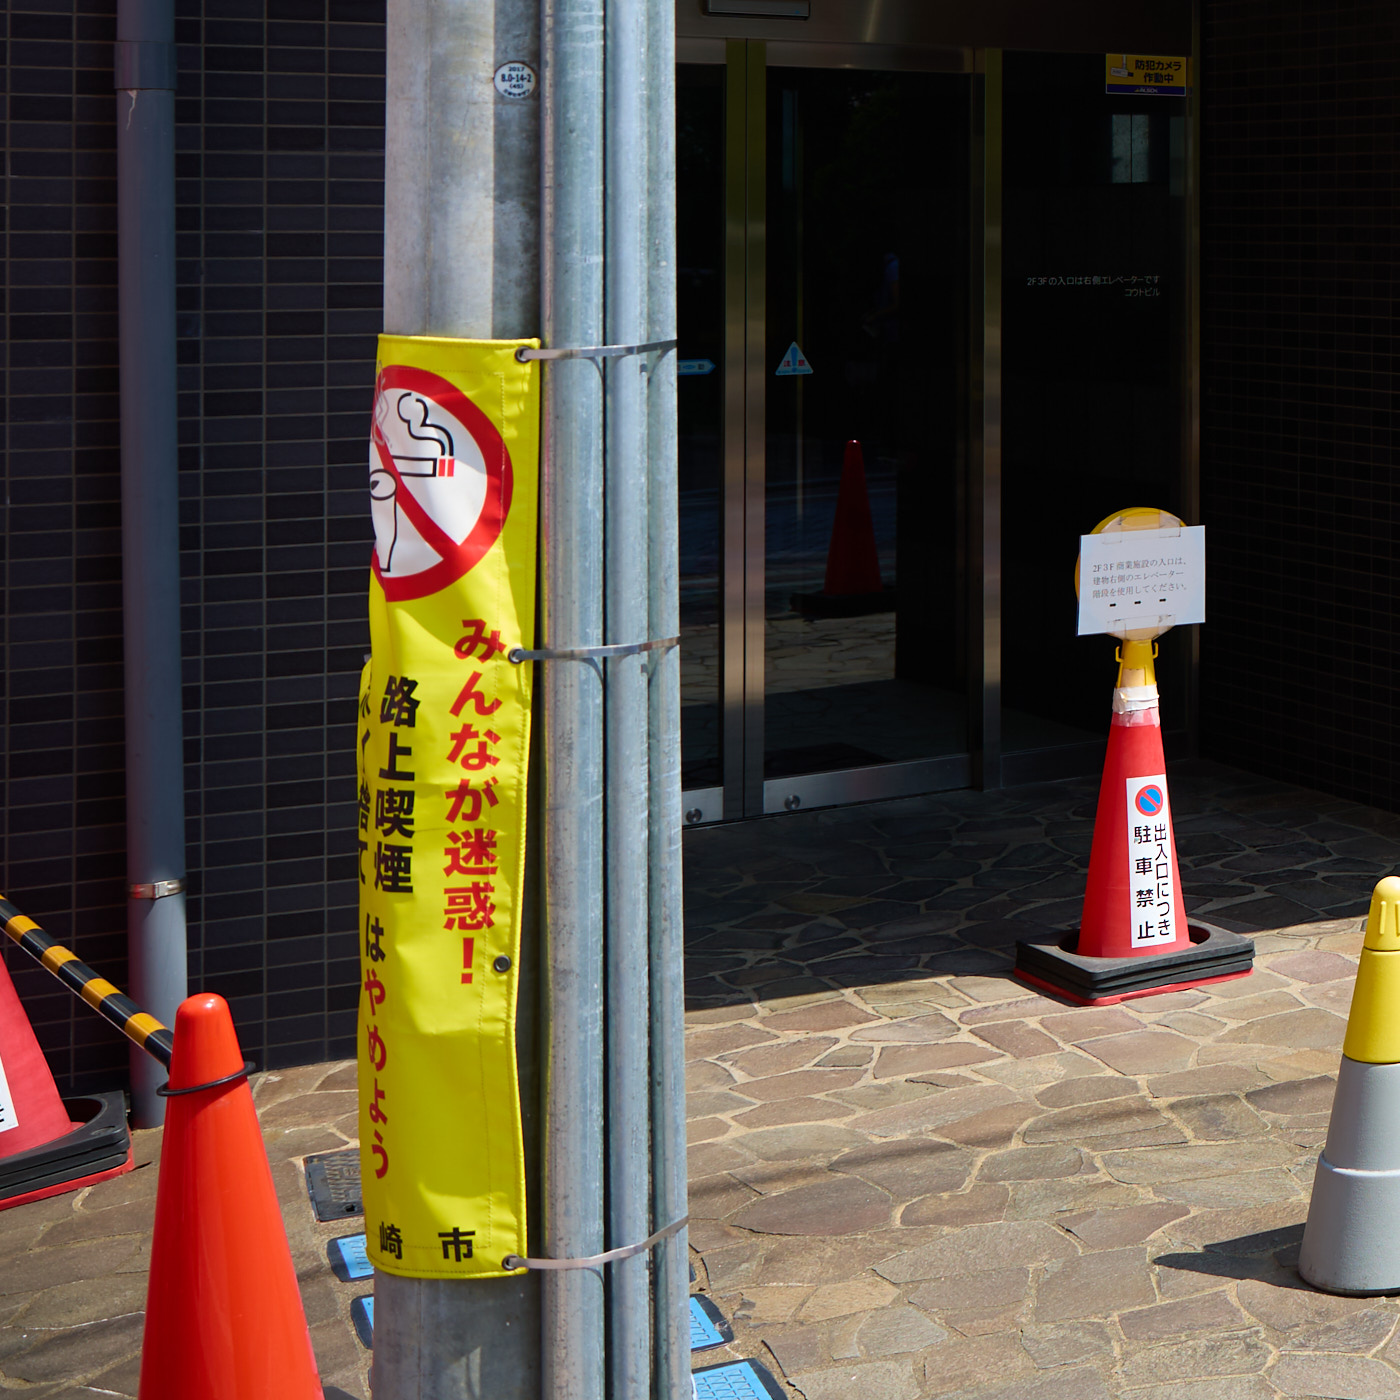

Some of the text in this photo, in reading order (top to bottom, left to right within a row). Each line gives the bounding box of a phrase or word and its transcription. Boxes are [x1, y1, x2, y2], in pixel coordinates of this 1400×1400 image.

[501, 73, 532, 83] 8.0-14-2
[1135, 59, 1181, 71] 防犯カメラ
[1143, 72, 1174, 83] 作動中
[1093, 570, 1184, 586] 建物右側のエレベーター
[374, 675, 421, 893] 路上喫煙
[443, 618, 507, 985] みんなが迷惑！
[1134, 823, 1156, 940] 駐車禁止
[1154, 822, 1172, 937] 出入口につき
